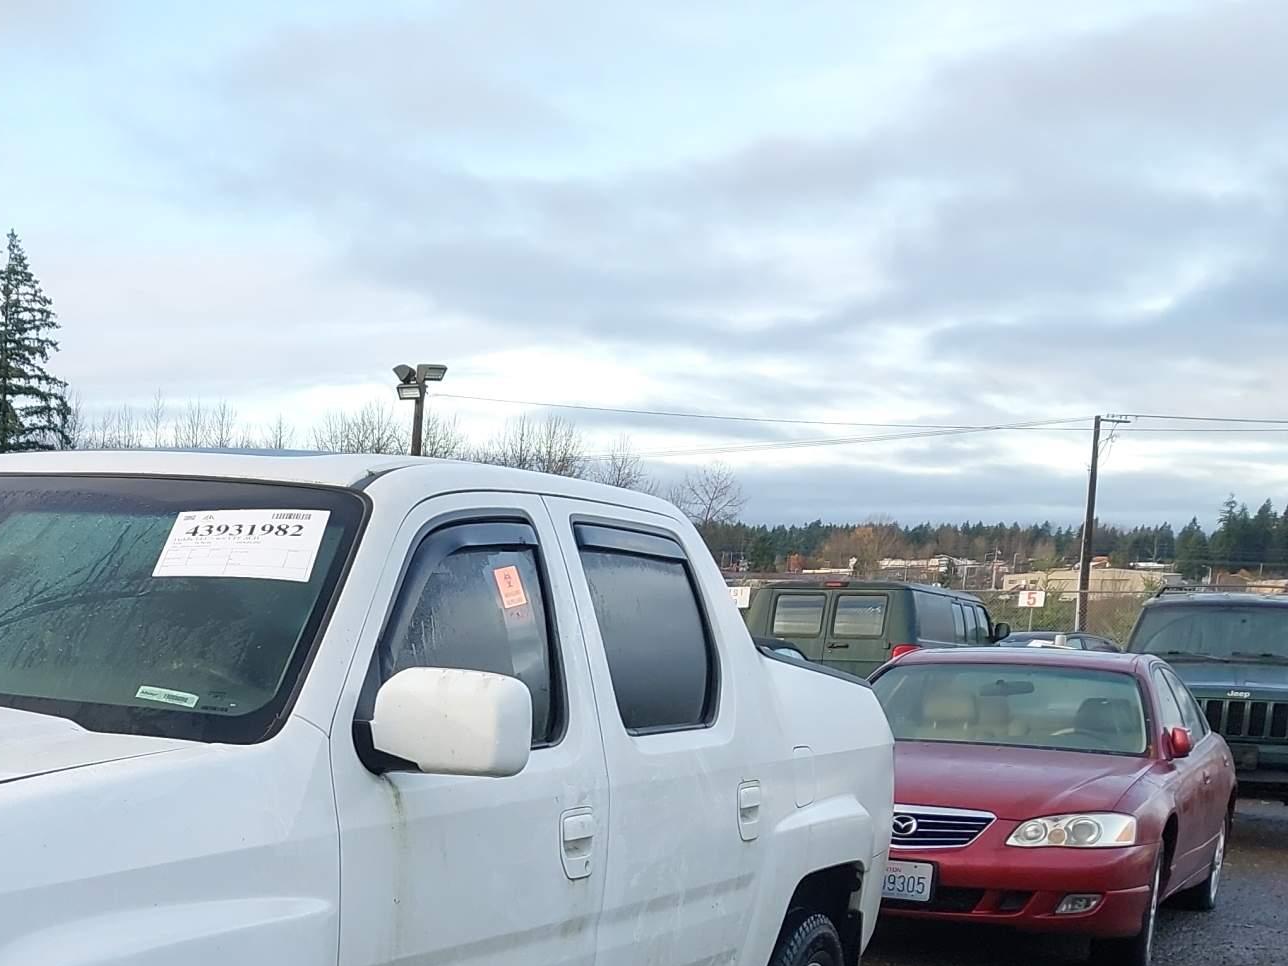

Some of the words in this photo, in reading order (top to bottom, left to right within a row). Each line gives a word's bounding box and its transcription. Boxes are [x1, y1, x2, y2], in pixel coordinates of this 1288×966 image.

[185, 523, 304, 537] 43931982
[1027, 592, 1037, 606] 5
[1226, 690, 1251, 699] Jeep
[882, 873, 927, 895] 9305
